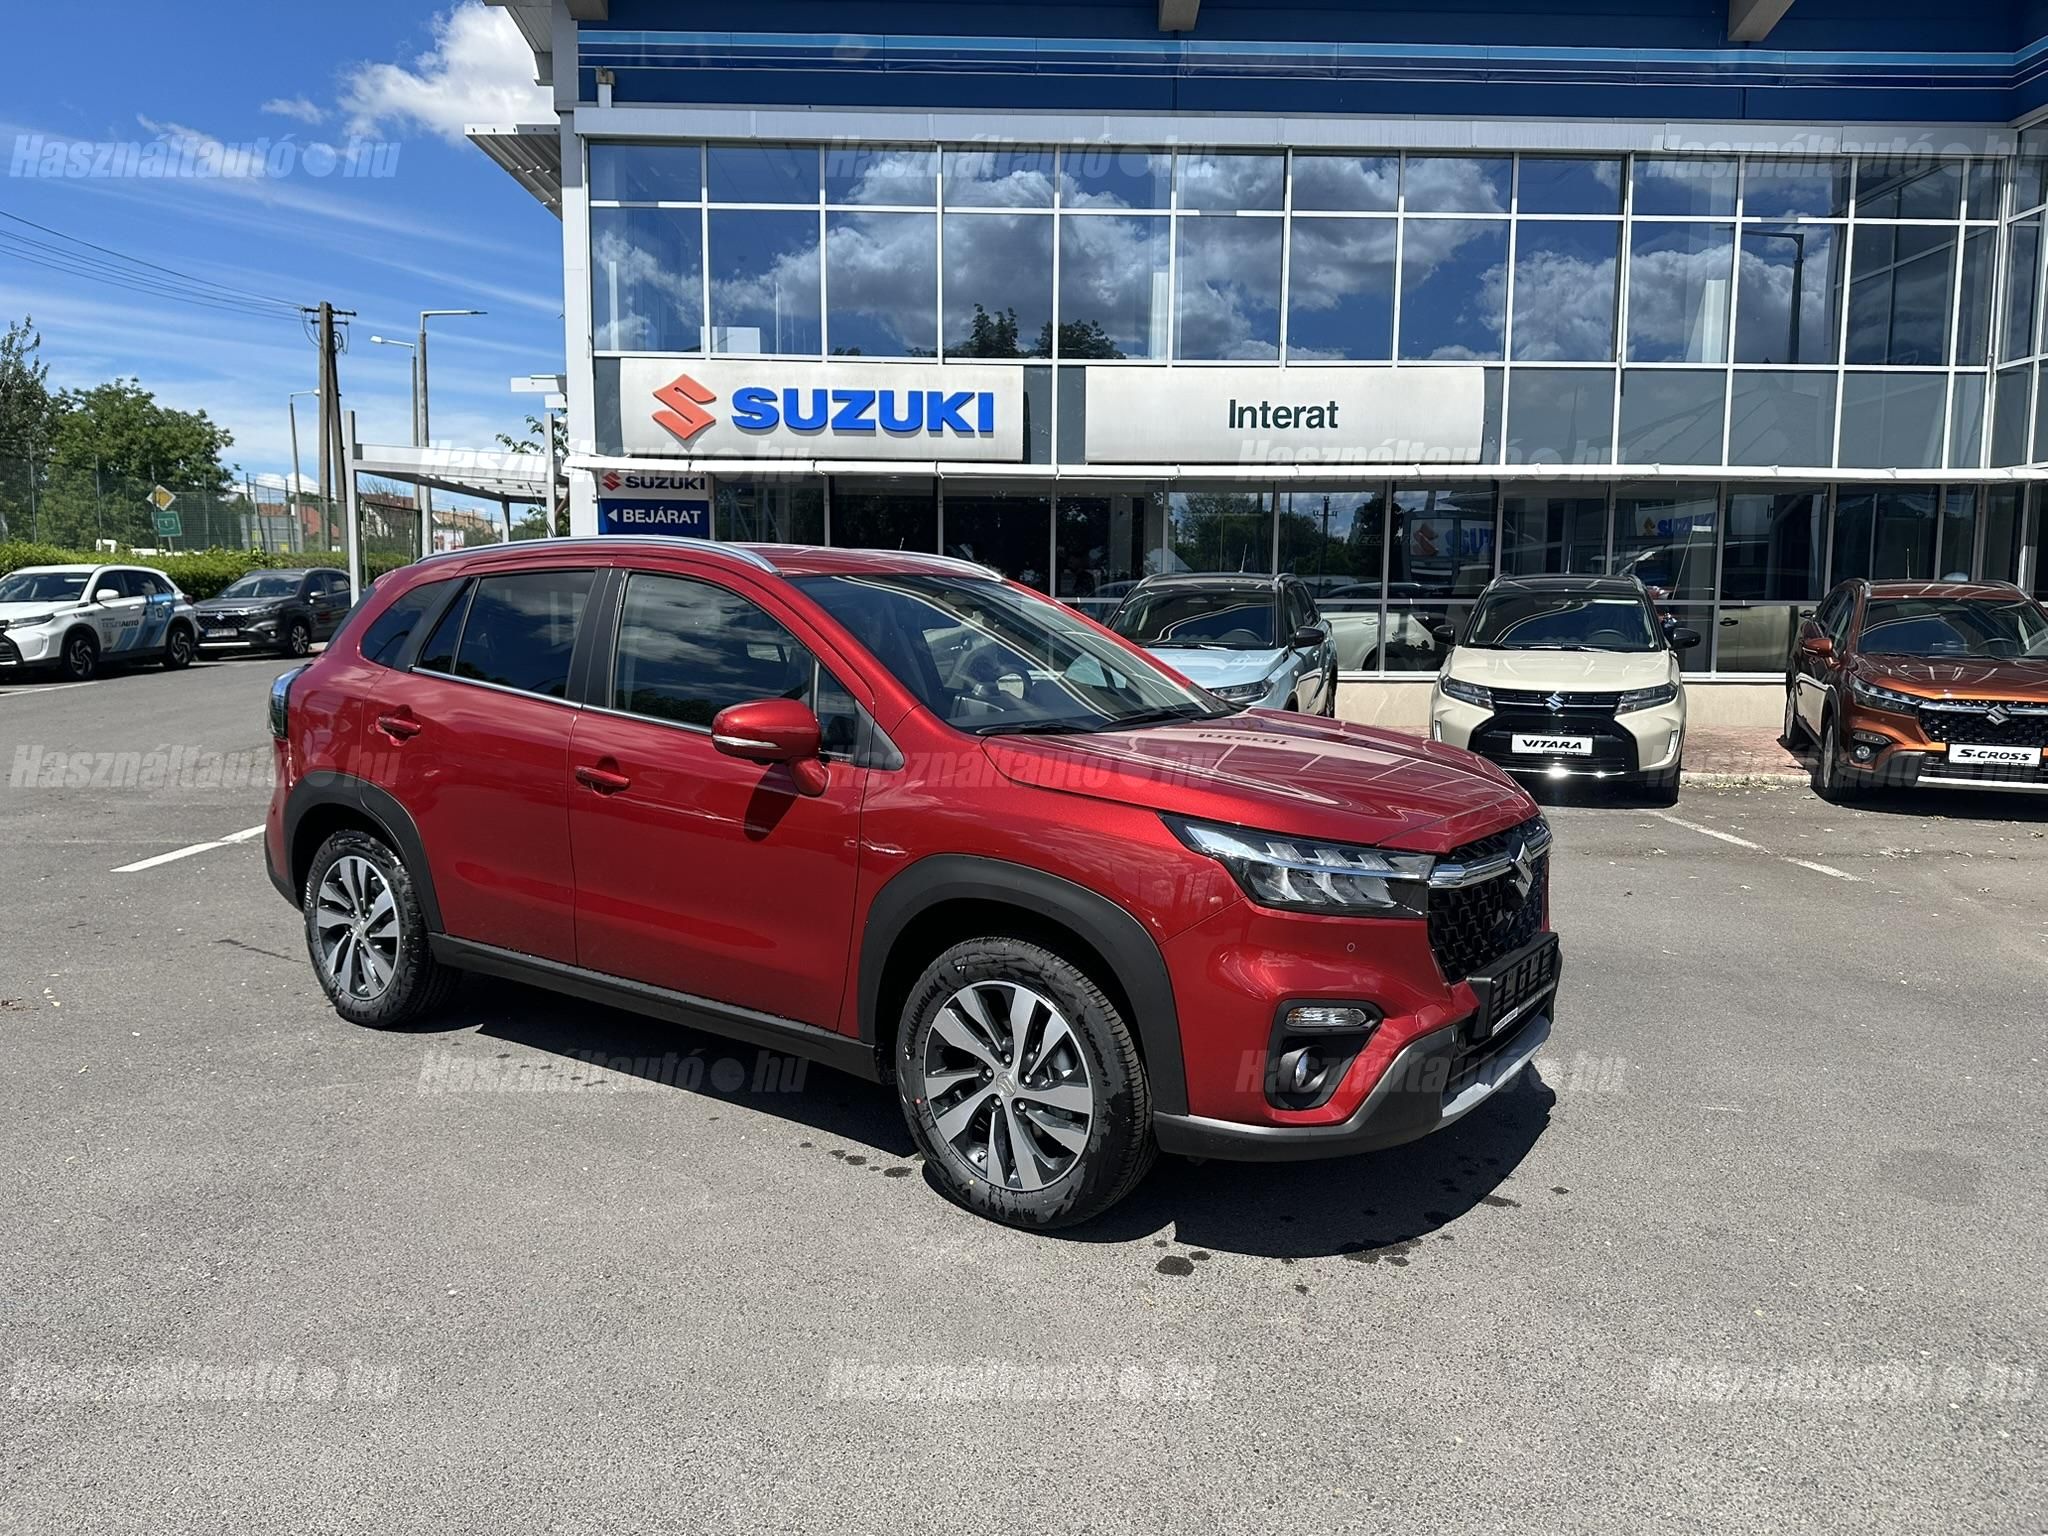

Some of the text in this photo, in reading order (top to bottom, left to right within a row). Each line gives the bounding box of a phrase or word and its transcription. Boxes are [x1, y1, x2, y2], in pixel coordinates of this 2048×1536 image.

[732, 386, 995, 434] SUZUKI
[1228, 398, 1340, 430] Interat
[625, 475, 706, 490] SUZUKI
[622, 506, 702, 525] BEJÁRAT
[1522, 739, 1583, 750] VITARA
